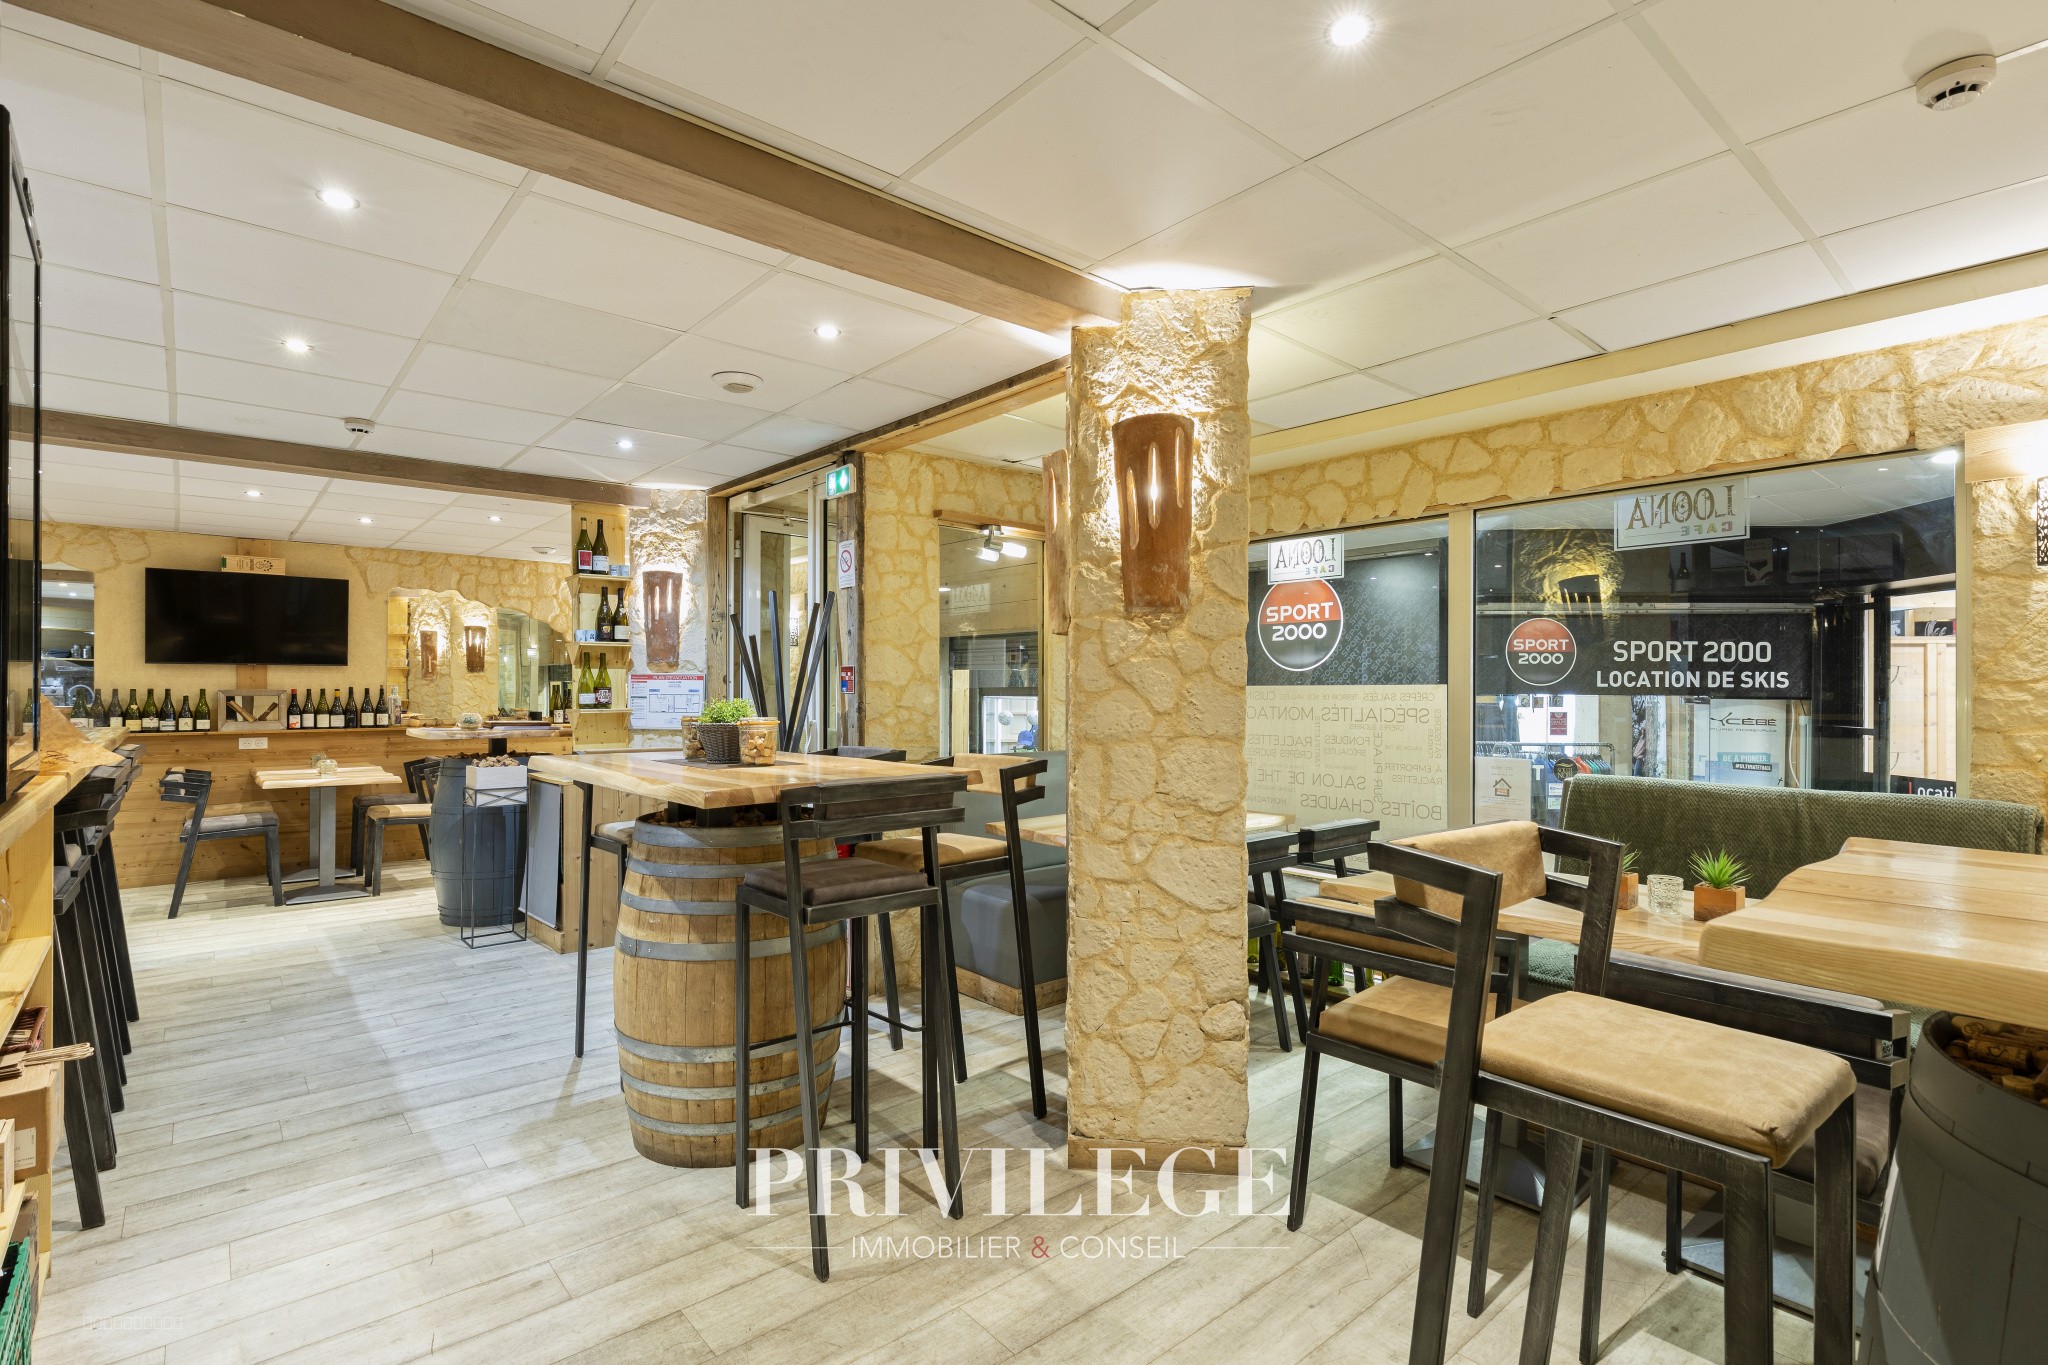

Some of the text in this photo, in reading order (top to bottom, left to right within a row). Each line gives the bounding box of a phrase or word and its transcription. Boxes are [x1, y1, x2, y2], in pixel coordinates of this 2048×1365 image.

[1266, 602, 1334, 622] SPORT
[1272, 623, 1327, 641] 2000
[1514, 639, 1569, 650] SPORT
[1614, 640, 1772, 662] SPORT 2000
[1518, 652, 1564, 664] 2000
[1597, 671, 1790, 688] LOCATION DE SKIS
